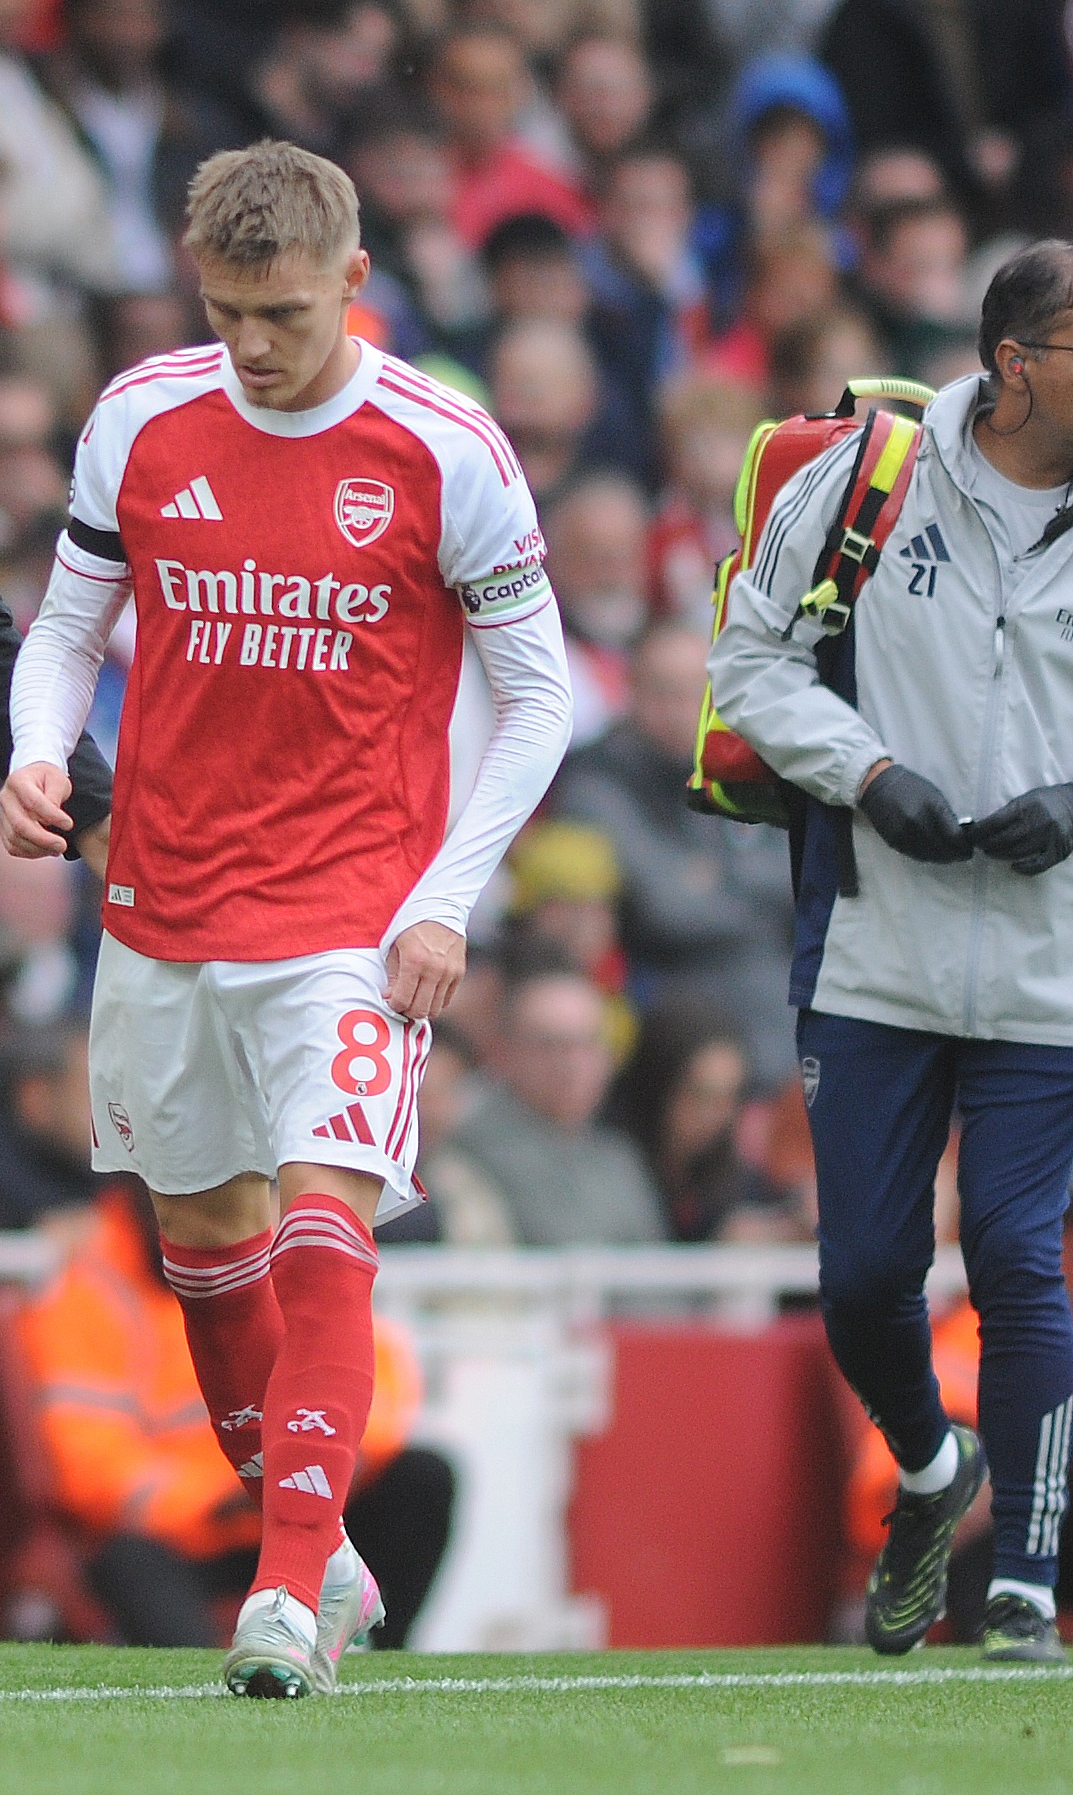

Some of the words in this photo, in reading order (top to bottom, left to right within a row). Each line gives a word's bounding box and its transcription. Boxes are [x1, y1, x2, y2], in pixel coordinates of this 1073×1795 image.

[344, 488, 386, 505] Arsenal
[154, 558, 392, 623] Emirates
[907, 563, 938, 599] 21
[186, 619, 233, 665] FLY
[239, 622, 354, 671] BETTER
[330, 1008, 393, 1098] 8
